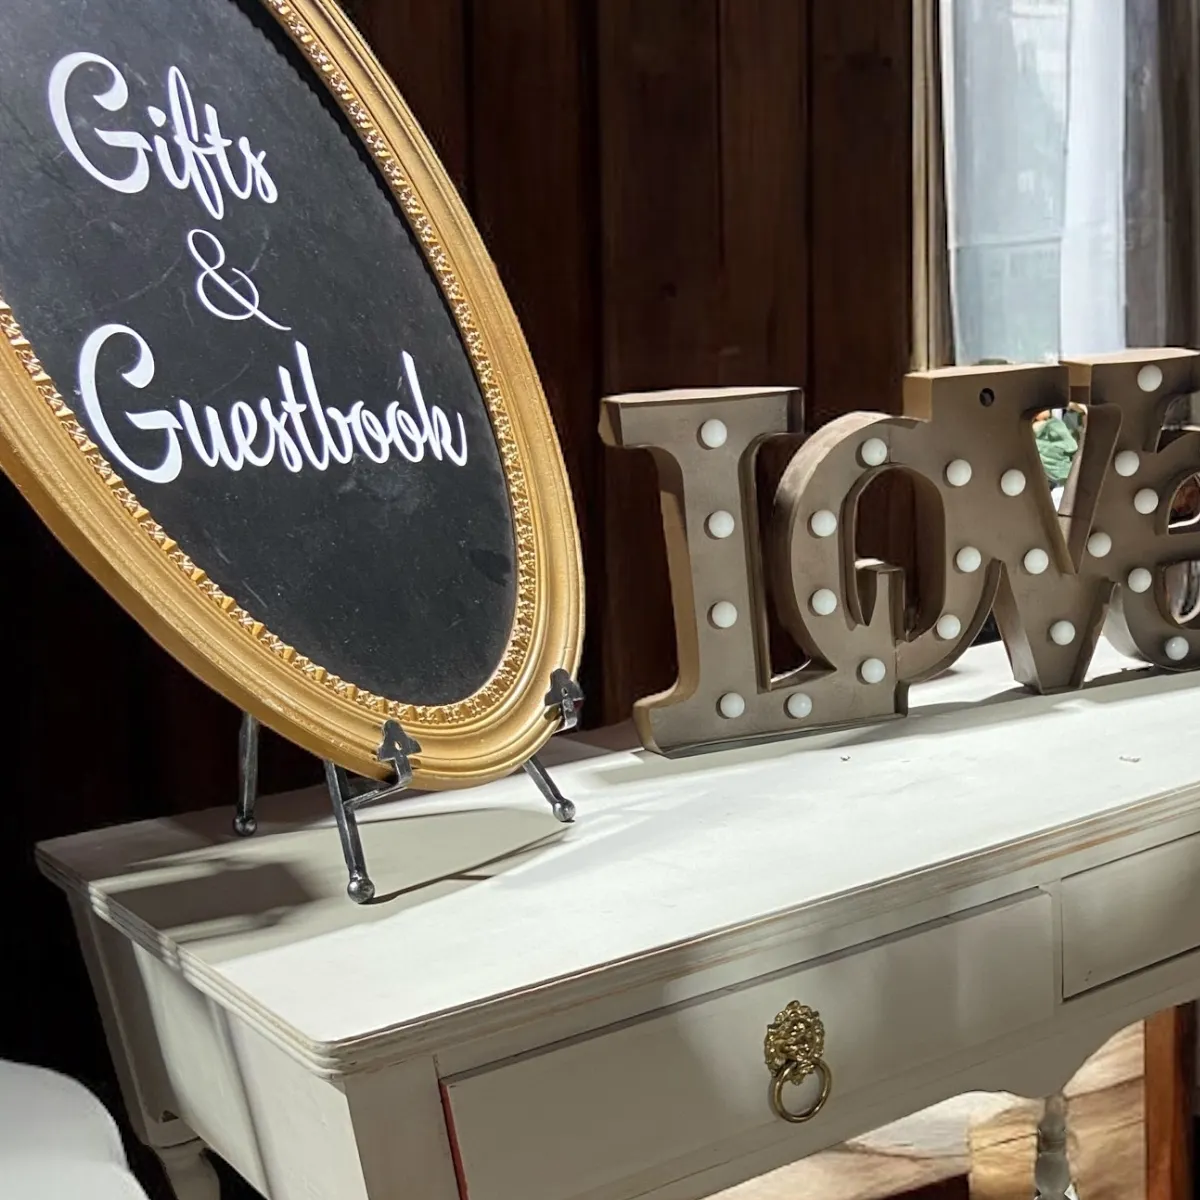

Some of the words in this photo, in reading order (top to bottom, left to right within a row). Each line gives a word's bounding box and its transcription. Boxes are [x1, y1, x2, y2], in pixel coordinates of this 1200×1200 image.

[47, 51, 279, 220] Gifts
[187, 228, 292, 331] &
[77, 323, 468, 483] Guestbook
